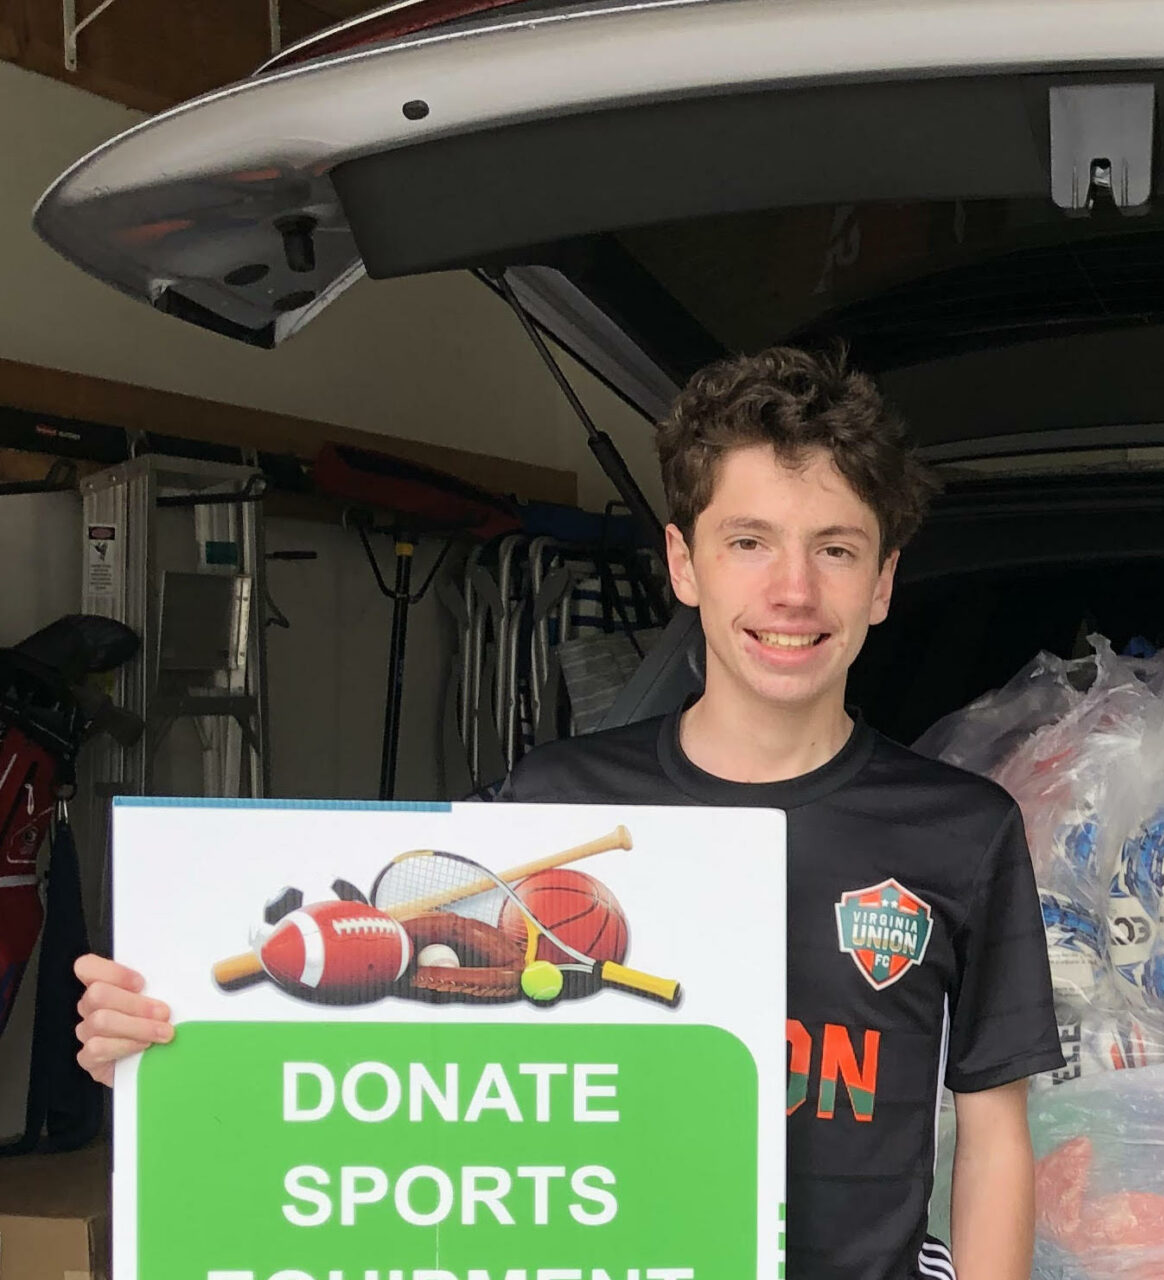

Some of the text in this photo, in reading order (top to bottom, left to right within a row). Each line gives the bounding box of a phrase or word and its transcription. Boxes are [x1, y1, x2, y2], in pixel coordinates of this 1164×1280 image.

[853, 911, 918, 933] VIRGINIA
[852, 923, 918, 955] UNION
[874, 953, 890, 968] FC
[282, 1061, 620, 1123] DONATE
[281, 1165, 619, 1226] SPORTS
